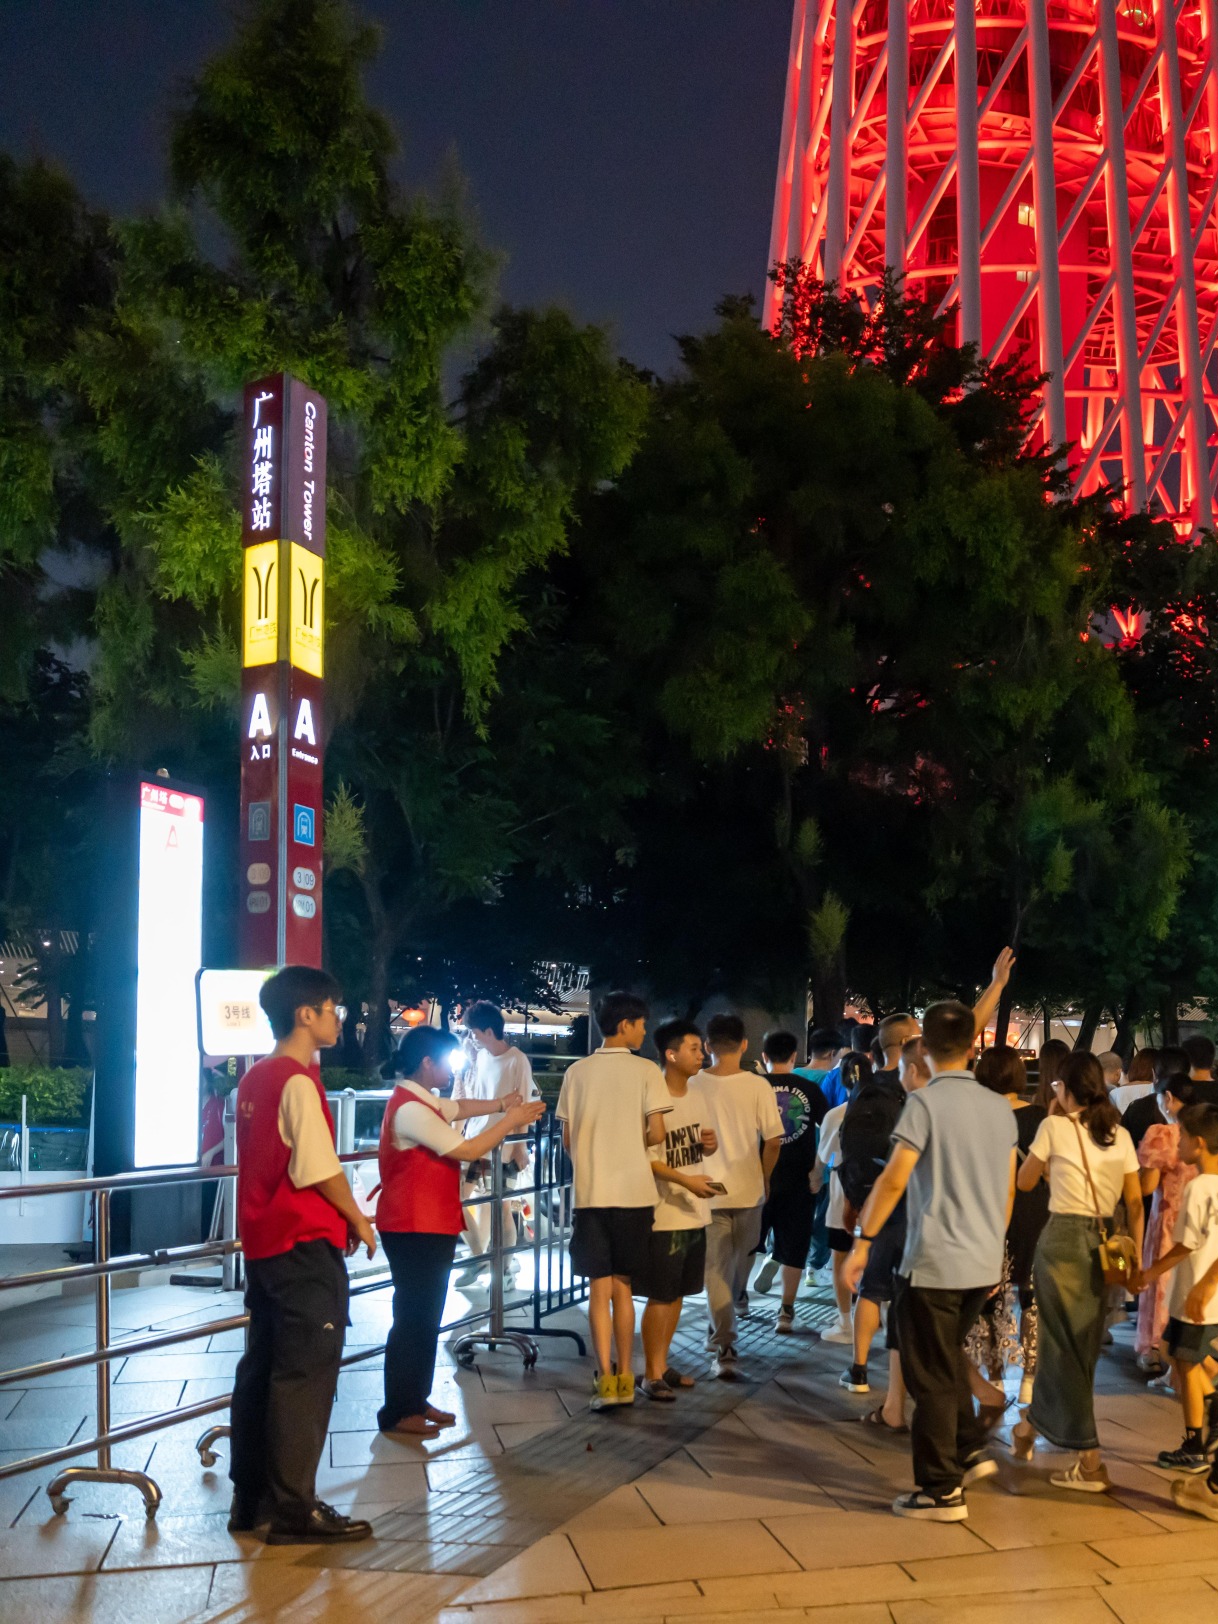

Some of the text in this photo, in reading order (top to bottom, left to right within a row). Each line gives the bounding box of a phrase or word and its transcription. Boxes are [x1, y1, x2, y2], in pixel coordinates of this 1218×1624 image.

[251, 391, 274, 531] 广州塔站
[303, 401, 317, 541] Canton Tower
[248, 693, 272, 738] A
[294, 698, 316, 746] A
[250, 744, 271, 761] 入口
[224, 1005, 251, 1019] 3号线
[791, 1087, 811, 1113] STUDIO
